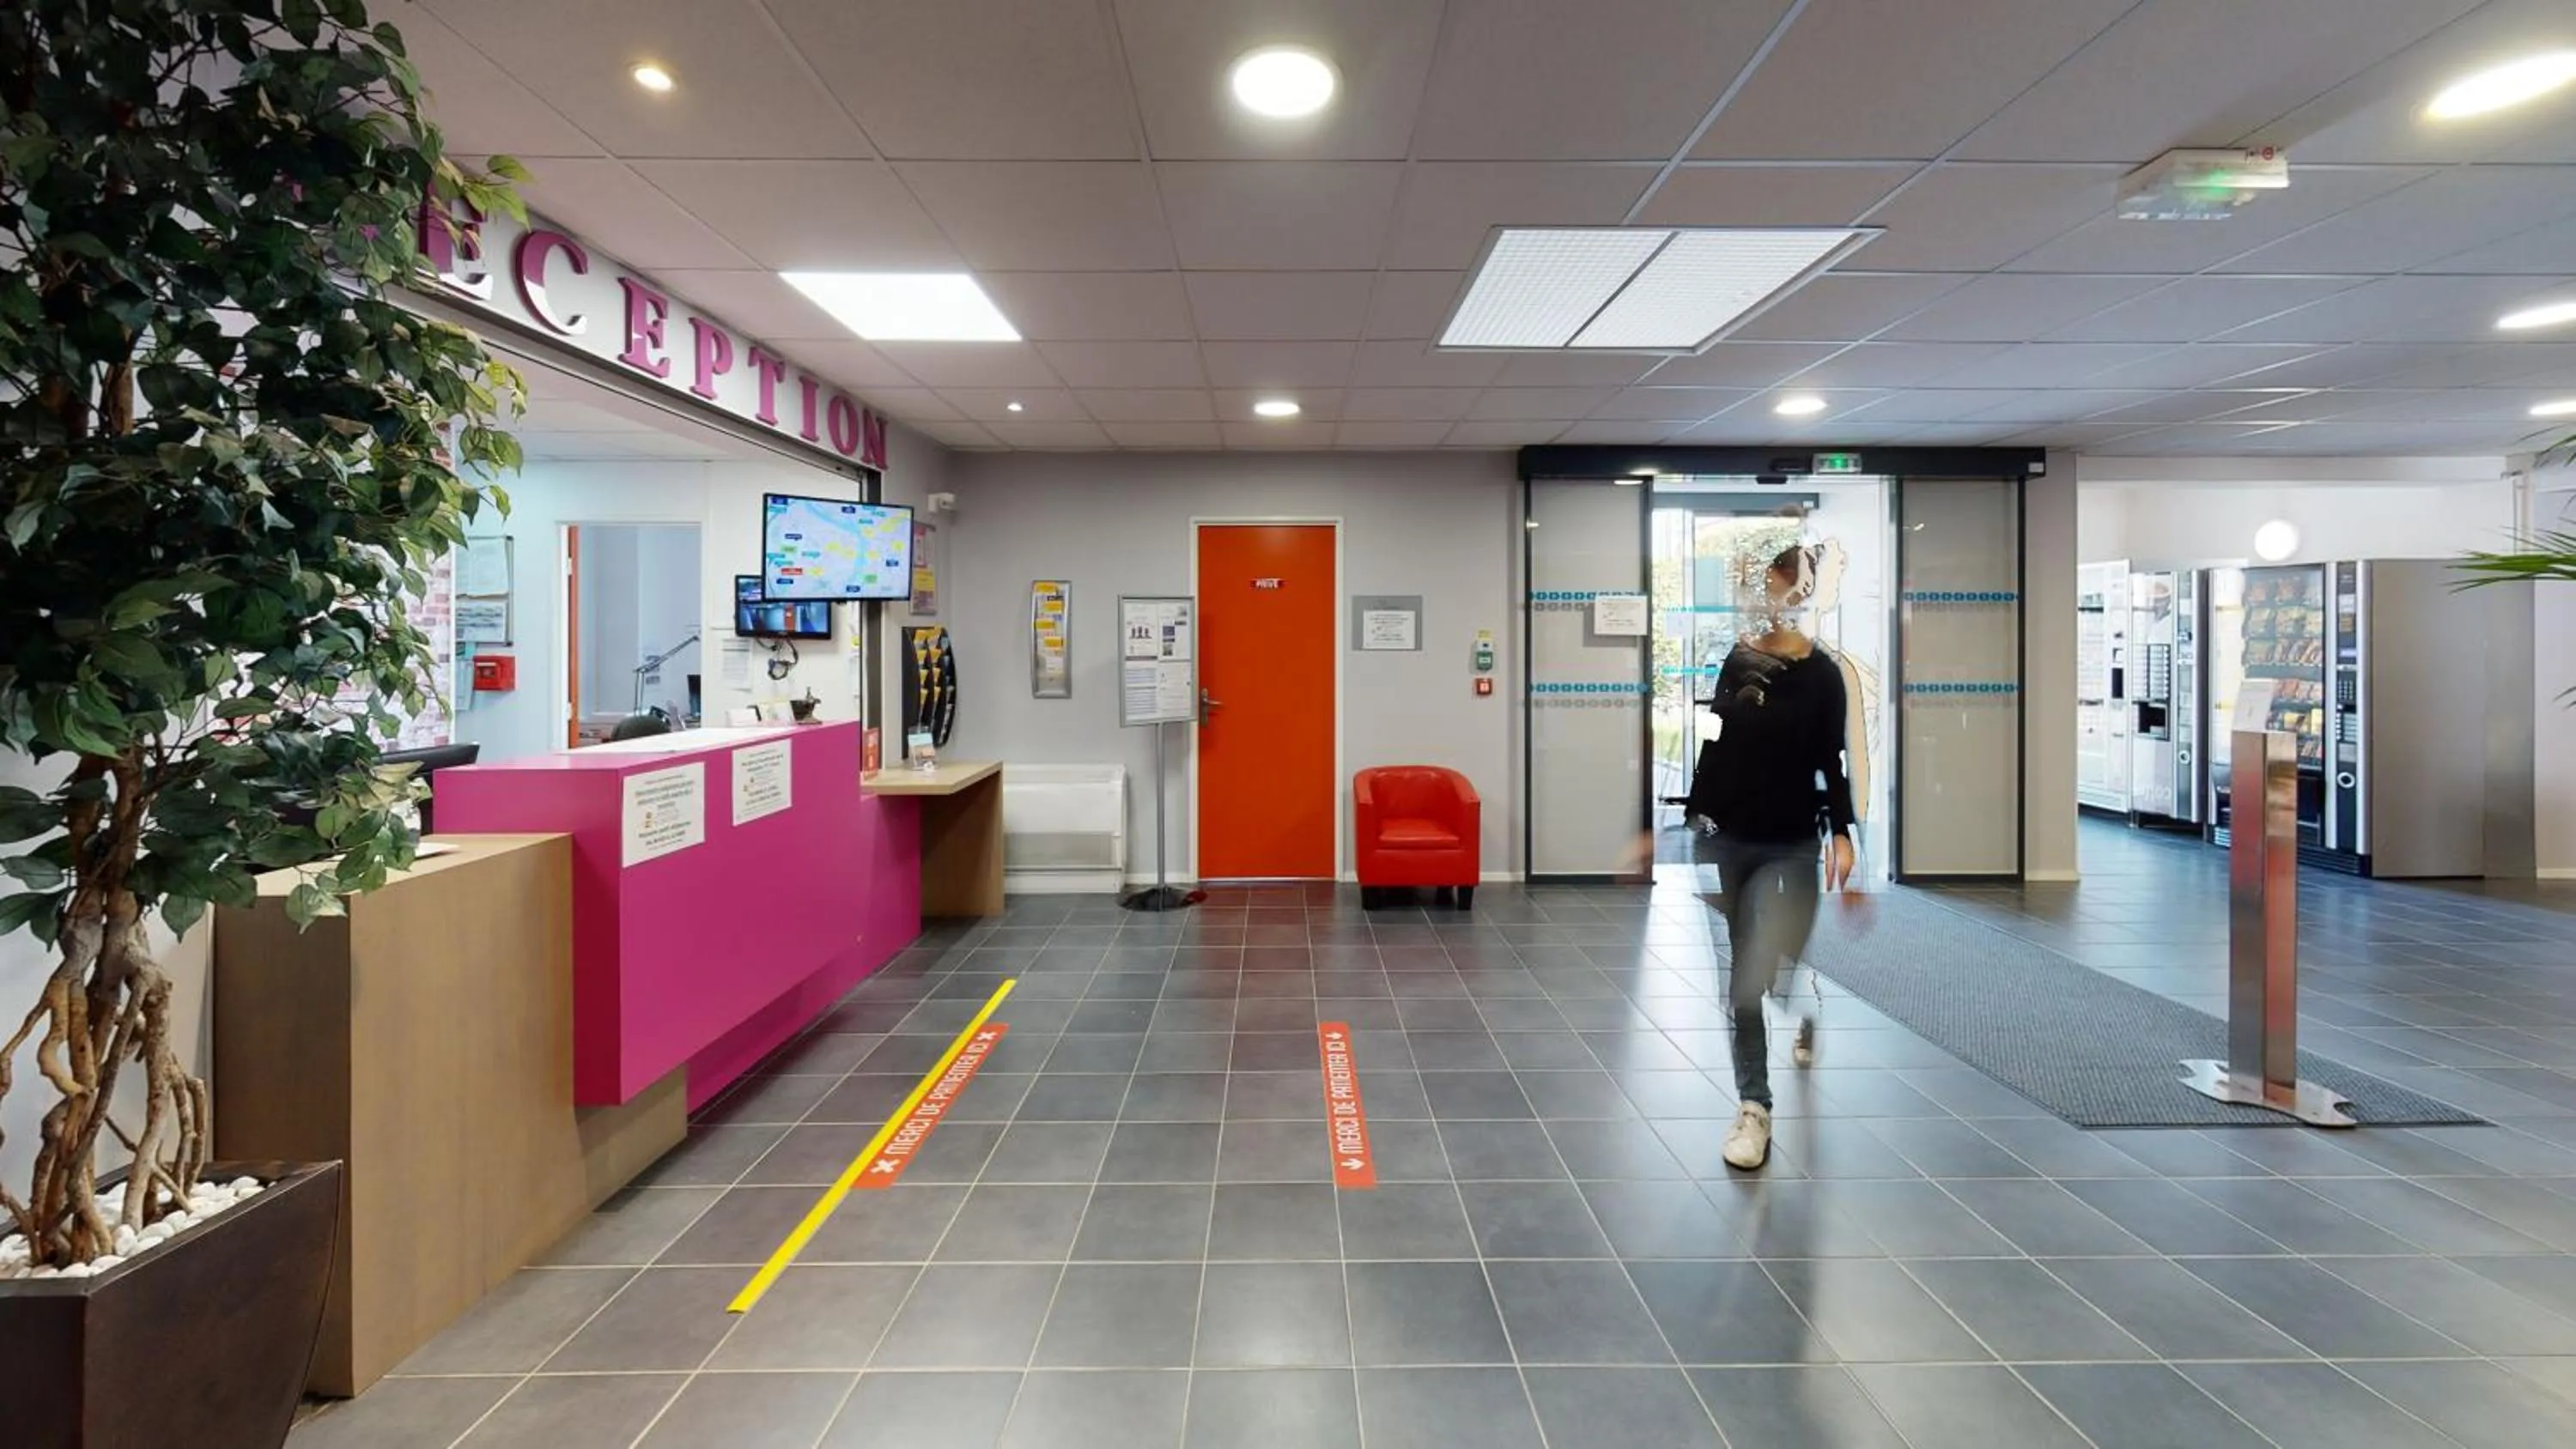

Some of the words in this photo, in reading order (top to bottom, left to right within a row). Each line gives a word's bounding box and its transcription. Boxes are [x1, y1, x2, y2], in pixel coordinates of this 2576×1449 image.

[364, 179, 887, 470] ECEPTION
[884, 1119, 933, 1155] MERCI
[915, 1102, 945, 1115] DE
[1333, 1101, 1357, 1115] DE
[1335, 1118, 1364, 1155] MERCI
